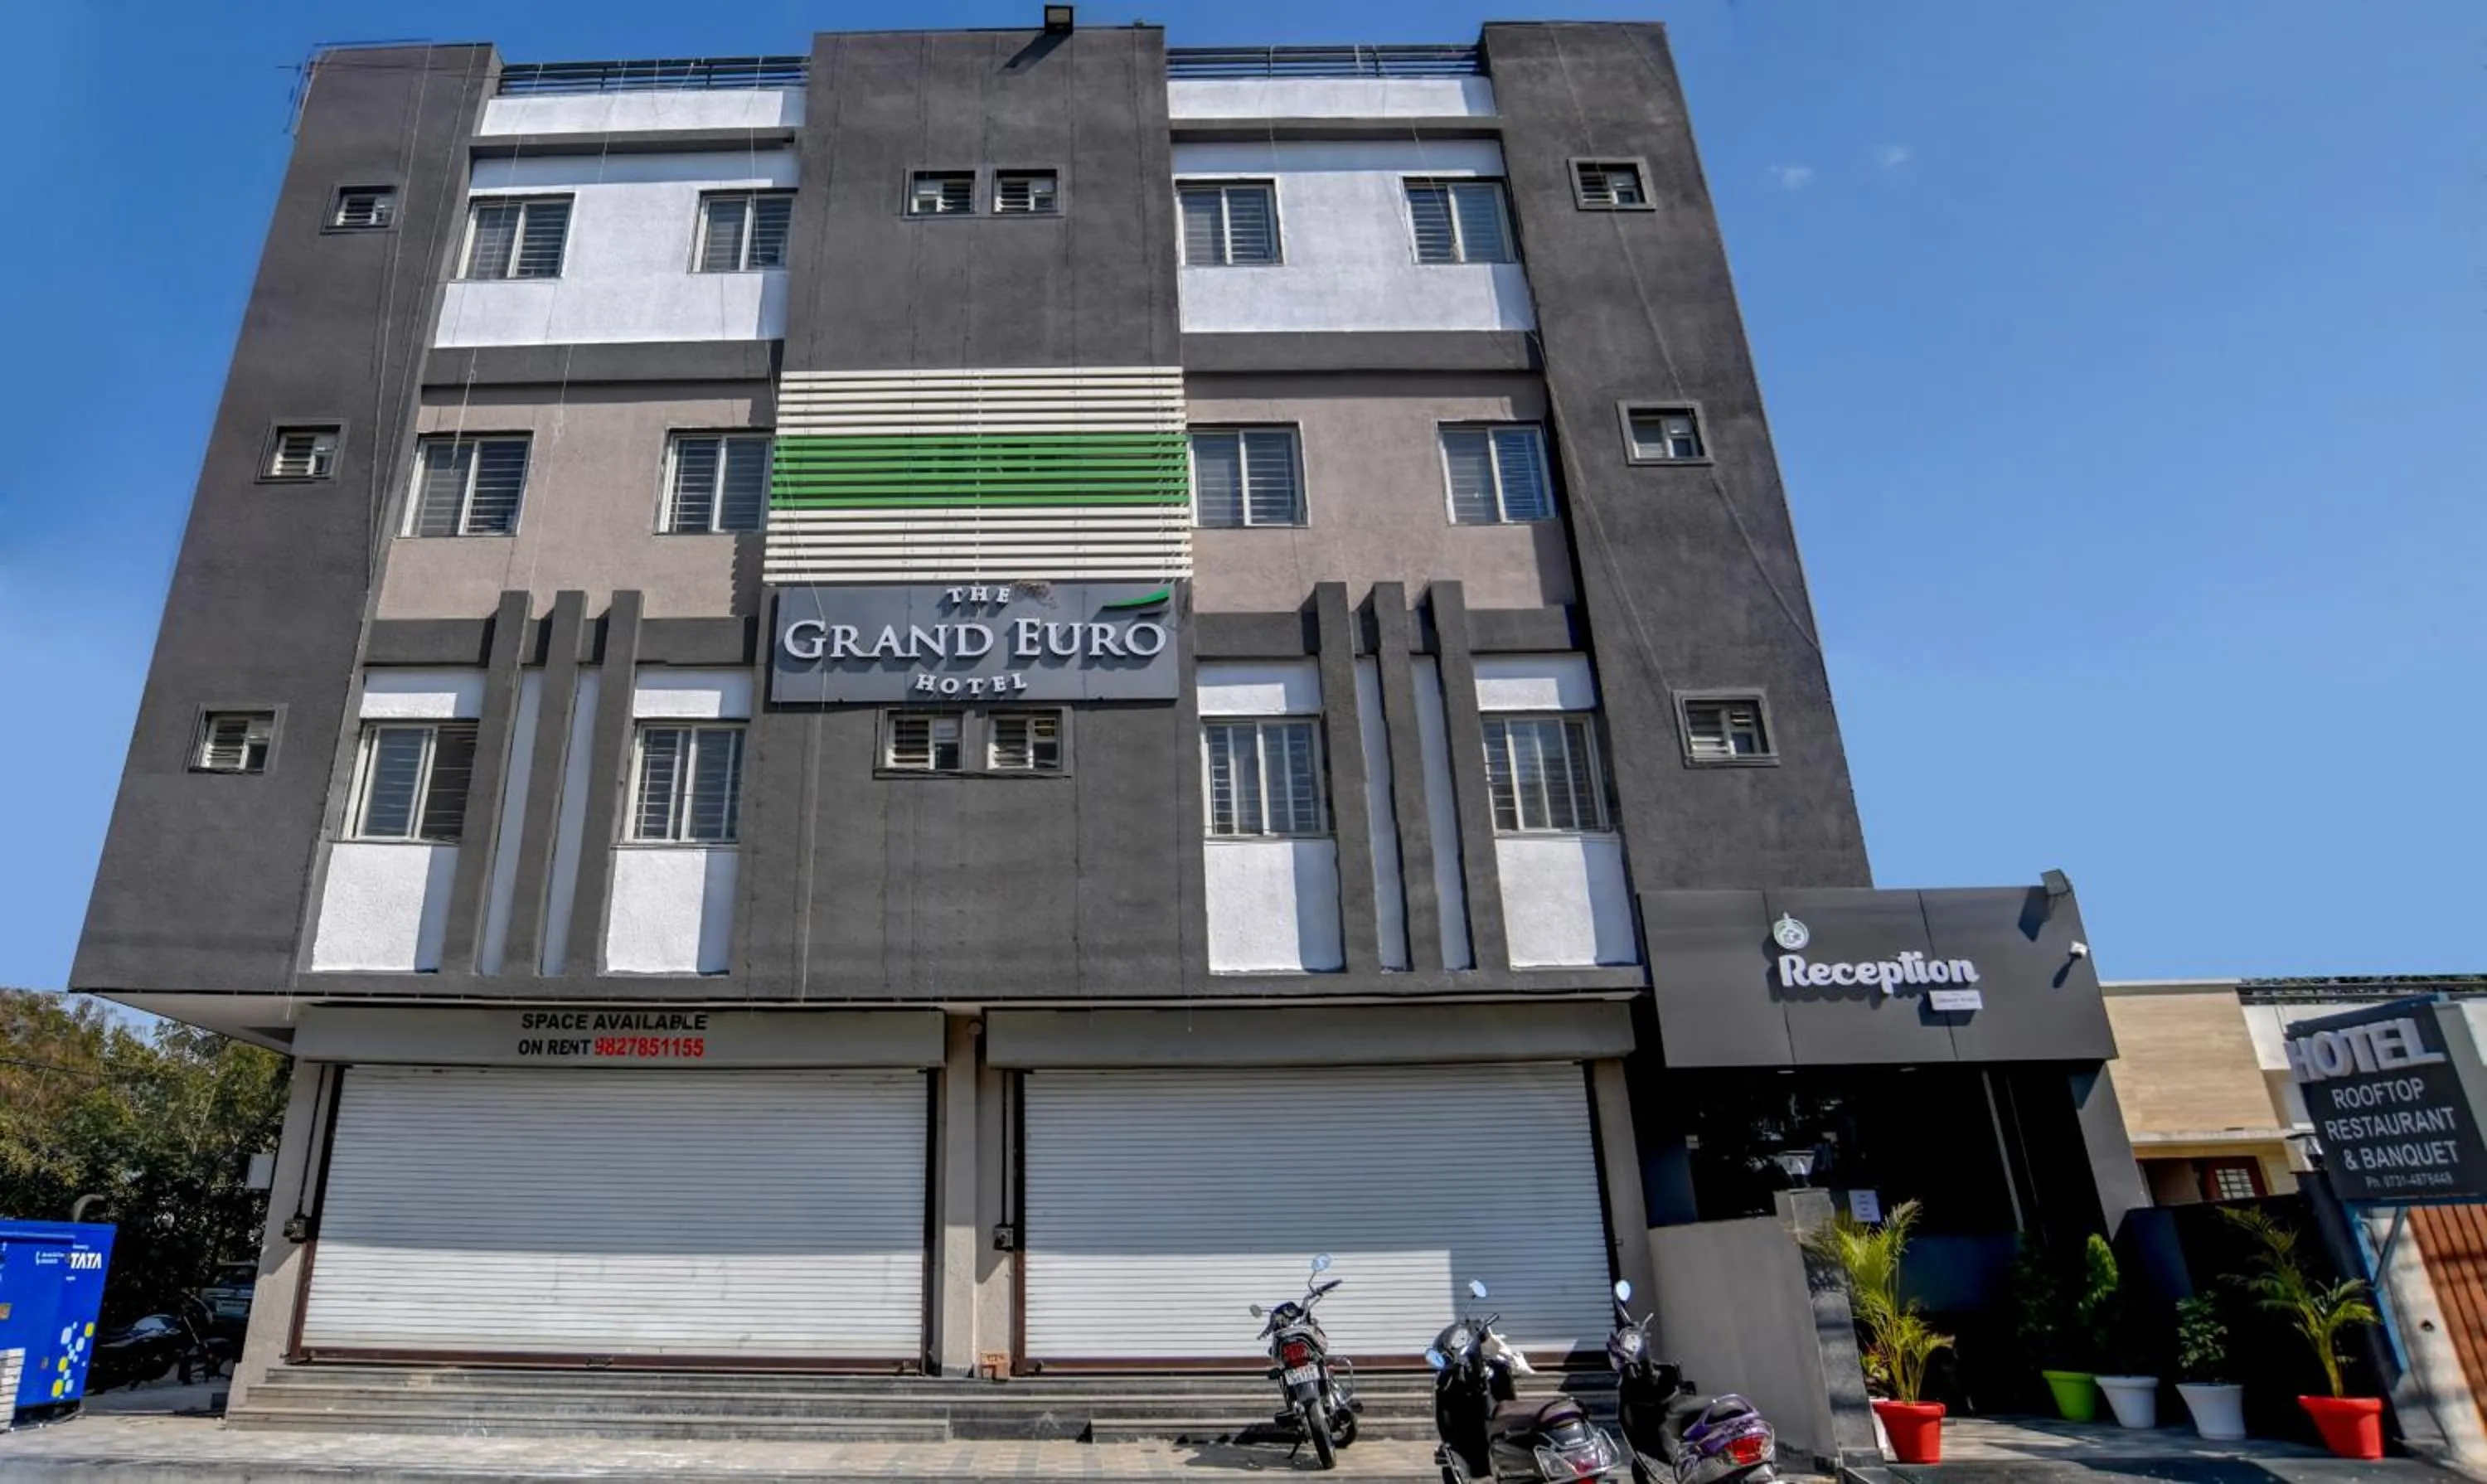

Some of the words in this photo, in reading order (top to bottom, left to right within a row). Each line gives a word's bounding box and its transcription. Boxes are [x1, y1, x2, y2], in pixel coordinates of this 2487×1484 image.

[947, 586, 1010, 604] THE
[783, 619, 994, 659] GRAND
[1014, 617, 1166, 657] EURO
[915, 672, 1028, 696] HOTEL
[1778, 951, 1980, 995] Reception
[521, 1013, 589, 1031] SPACE
[593, 1013, 709, 1031] AVAILABLE
[518, 1039, 543, 1055] ON
[547, 1039, 591, 1055] RENT
[594, 1038, 704, 1057] 9827851155
[2284, 1017, 2446, 1084] HOTEL
[2330, 1078, 2425, 1109] ROOFTOP
[2325, 1107, 2456, 1142] RESTAURANT
[2344, 1149, 2360, 1171] &
[2360, 1141, 2459, 1170] BANQUET
[70, 1252, 102, 1269] TATA
